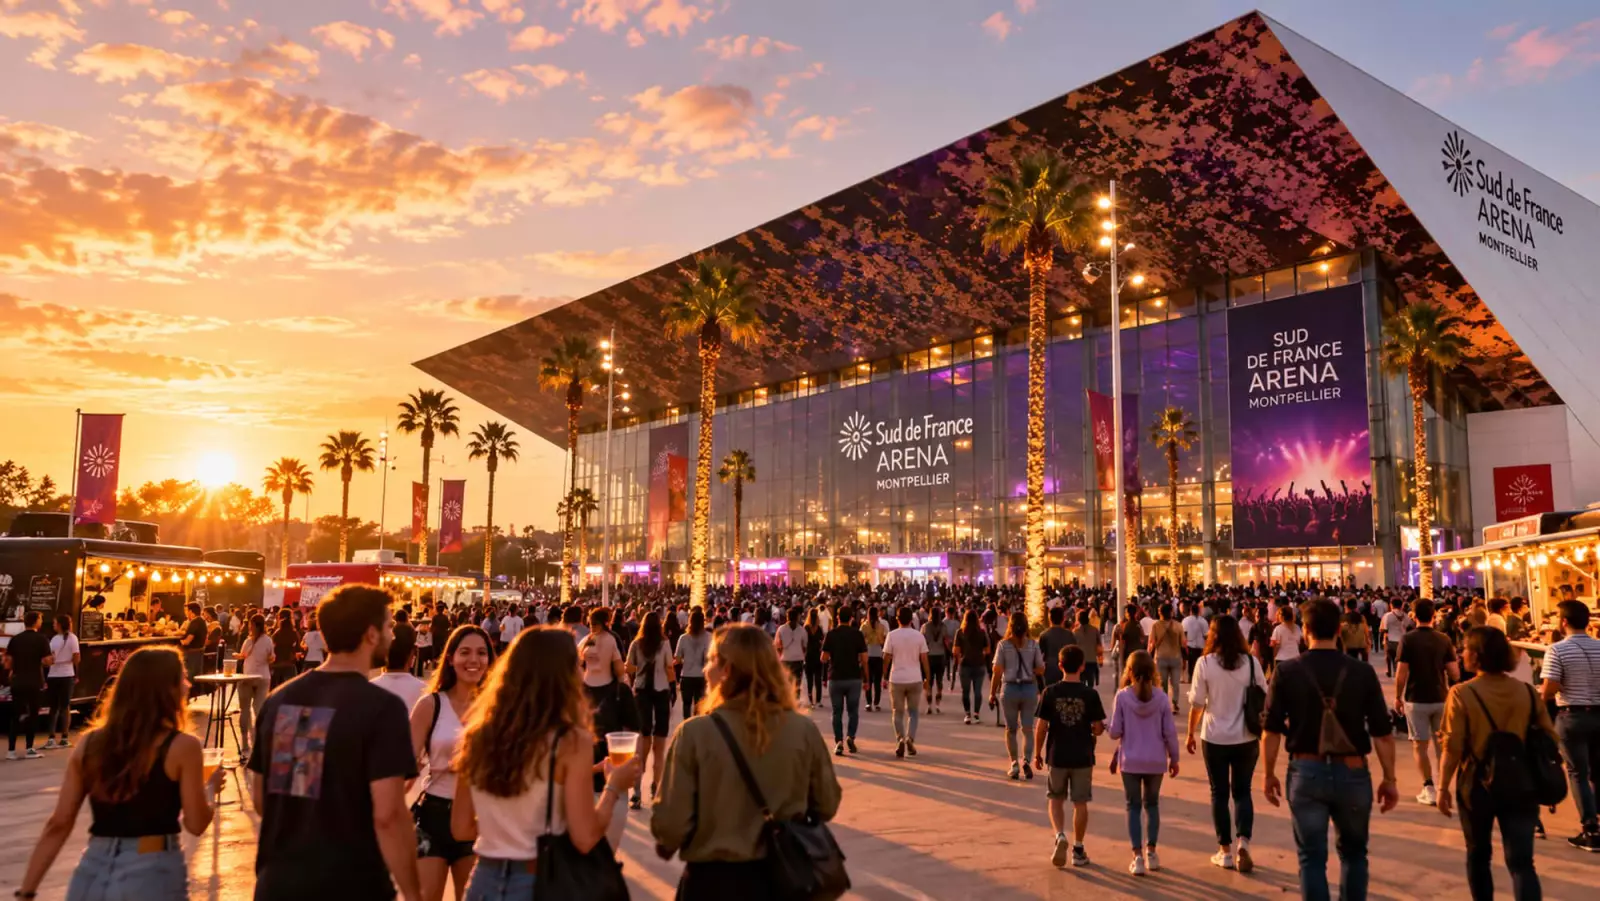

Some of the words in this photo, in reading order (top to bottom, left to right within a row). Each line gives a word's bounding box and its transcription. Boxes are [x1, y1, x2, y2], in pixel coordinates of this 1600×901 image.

[1476, 159, 1503, 201] Sud
[1506, 178, 1521, 211] de
[1524, 188, 1564, 235] France
[1478, 197, 1536, 249] ARENA
[1273, 328, 1309, 347] SUD
[1247, 353, 1268, 369] DE
[1273, 341, 1343, 366] FRANCE
[1248, 361, 1340, 393] ARENA
[1249, 386, 1341, 409] MONTPELLIER
[875, 418, 902, 446] Sud
[905, 418, 922, 441] de
[923, 414, 974, 439] France
[876, 443, 949, 473] ARENA
[876, 472, 950, 491] MONTPELLIER
